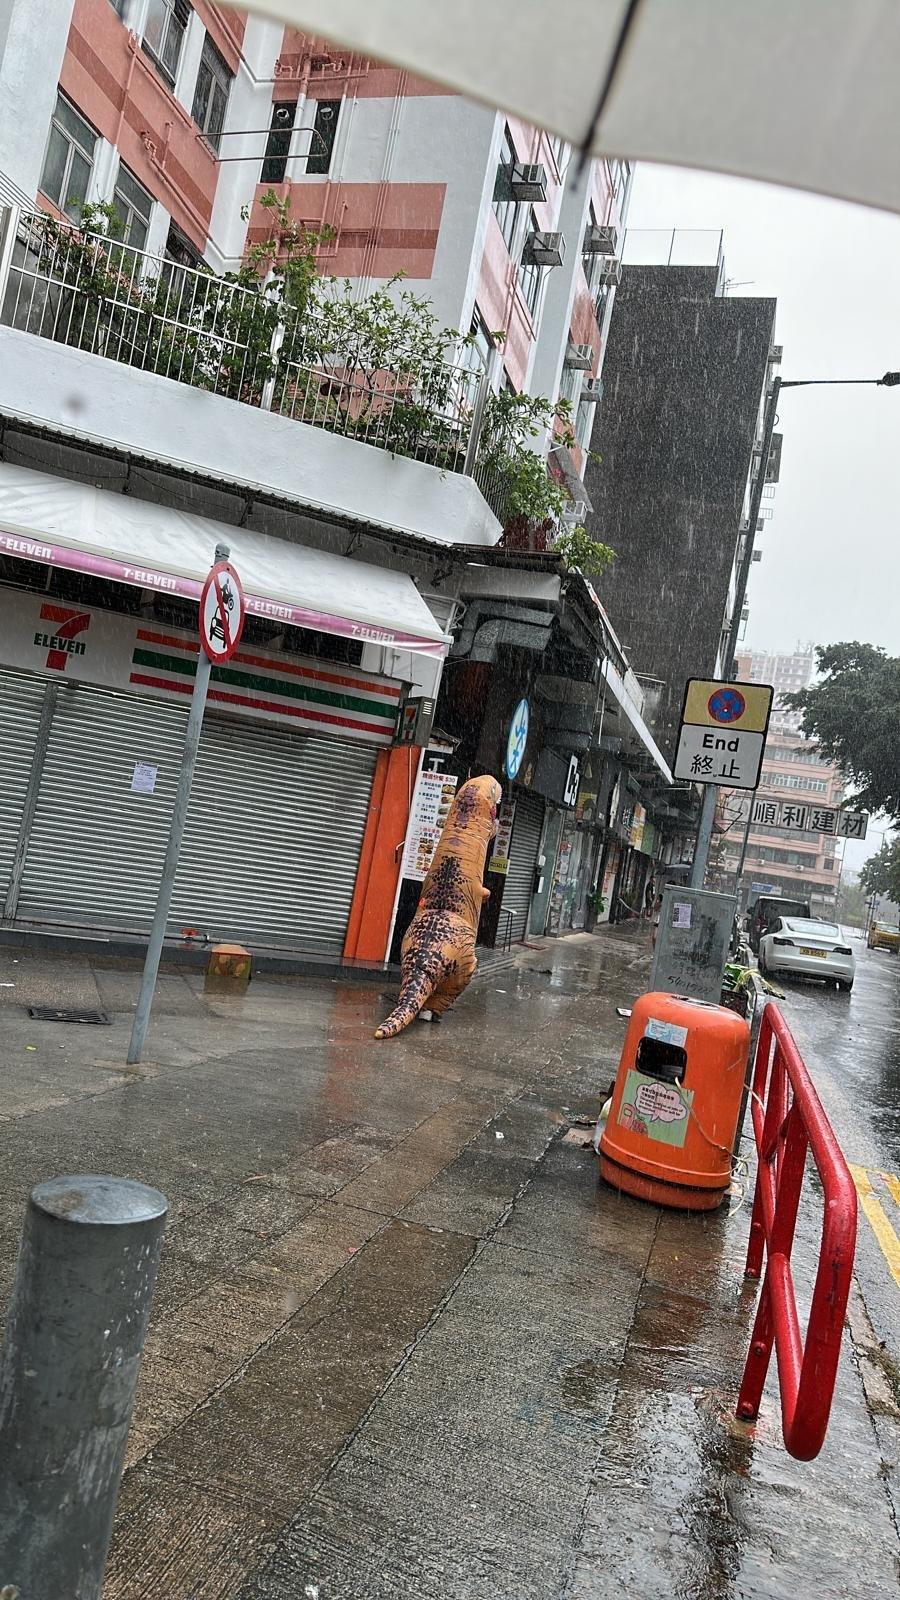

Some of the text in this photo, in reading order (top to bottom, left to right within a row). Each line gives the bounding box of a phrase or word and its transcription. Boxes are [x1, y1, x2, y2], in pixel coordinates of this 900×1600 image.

[702, 733, 740, 753] End
[690, 754, 741, 780] 終止
[753, 802, 865, 836] 順利建材
